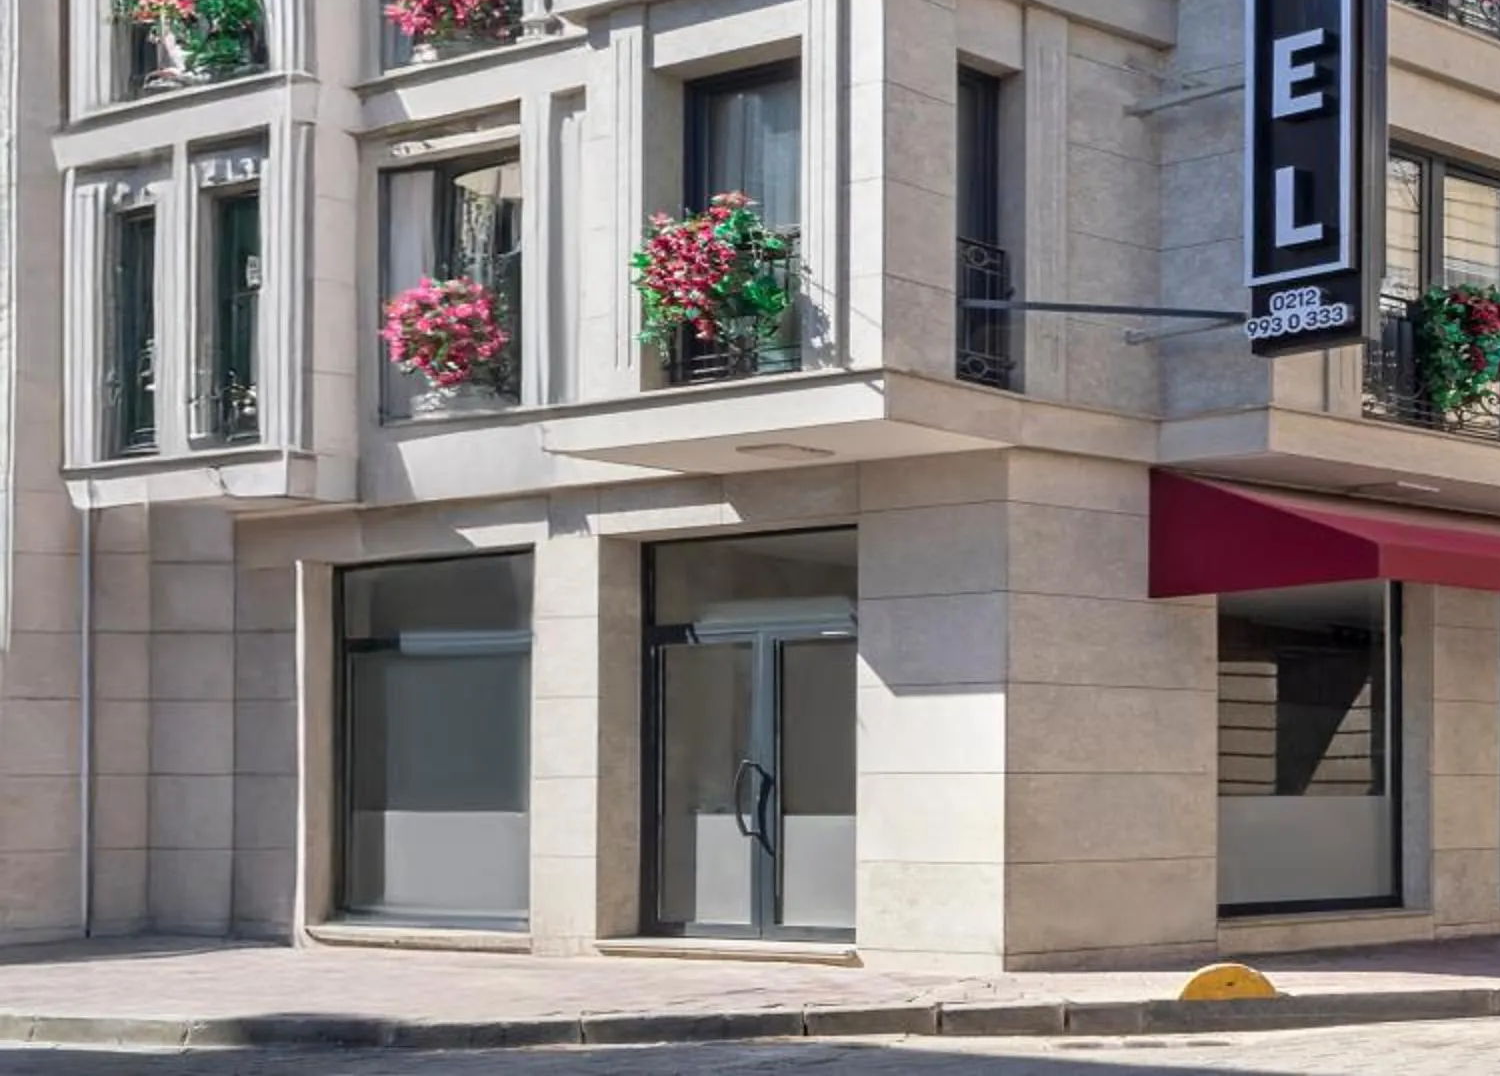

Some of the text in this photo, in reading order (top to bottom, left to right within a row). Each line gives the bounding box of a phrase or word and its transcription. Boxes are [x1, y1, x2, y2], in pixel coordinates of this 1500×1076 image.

[1271, 288, 1319, 313] 0212
[1246, 305, 1345, 337] 993 0 333
